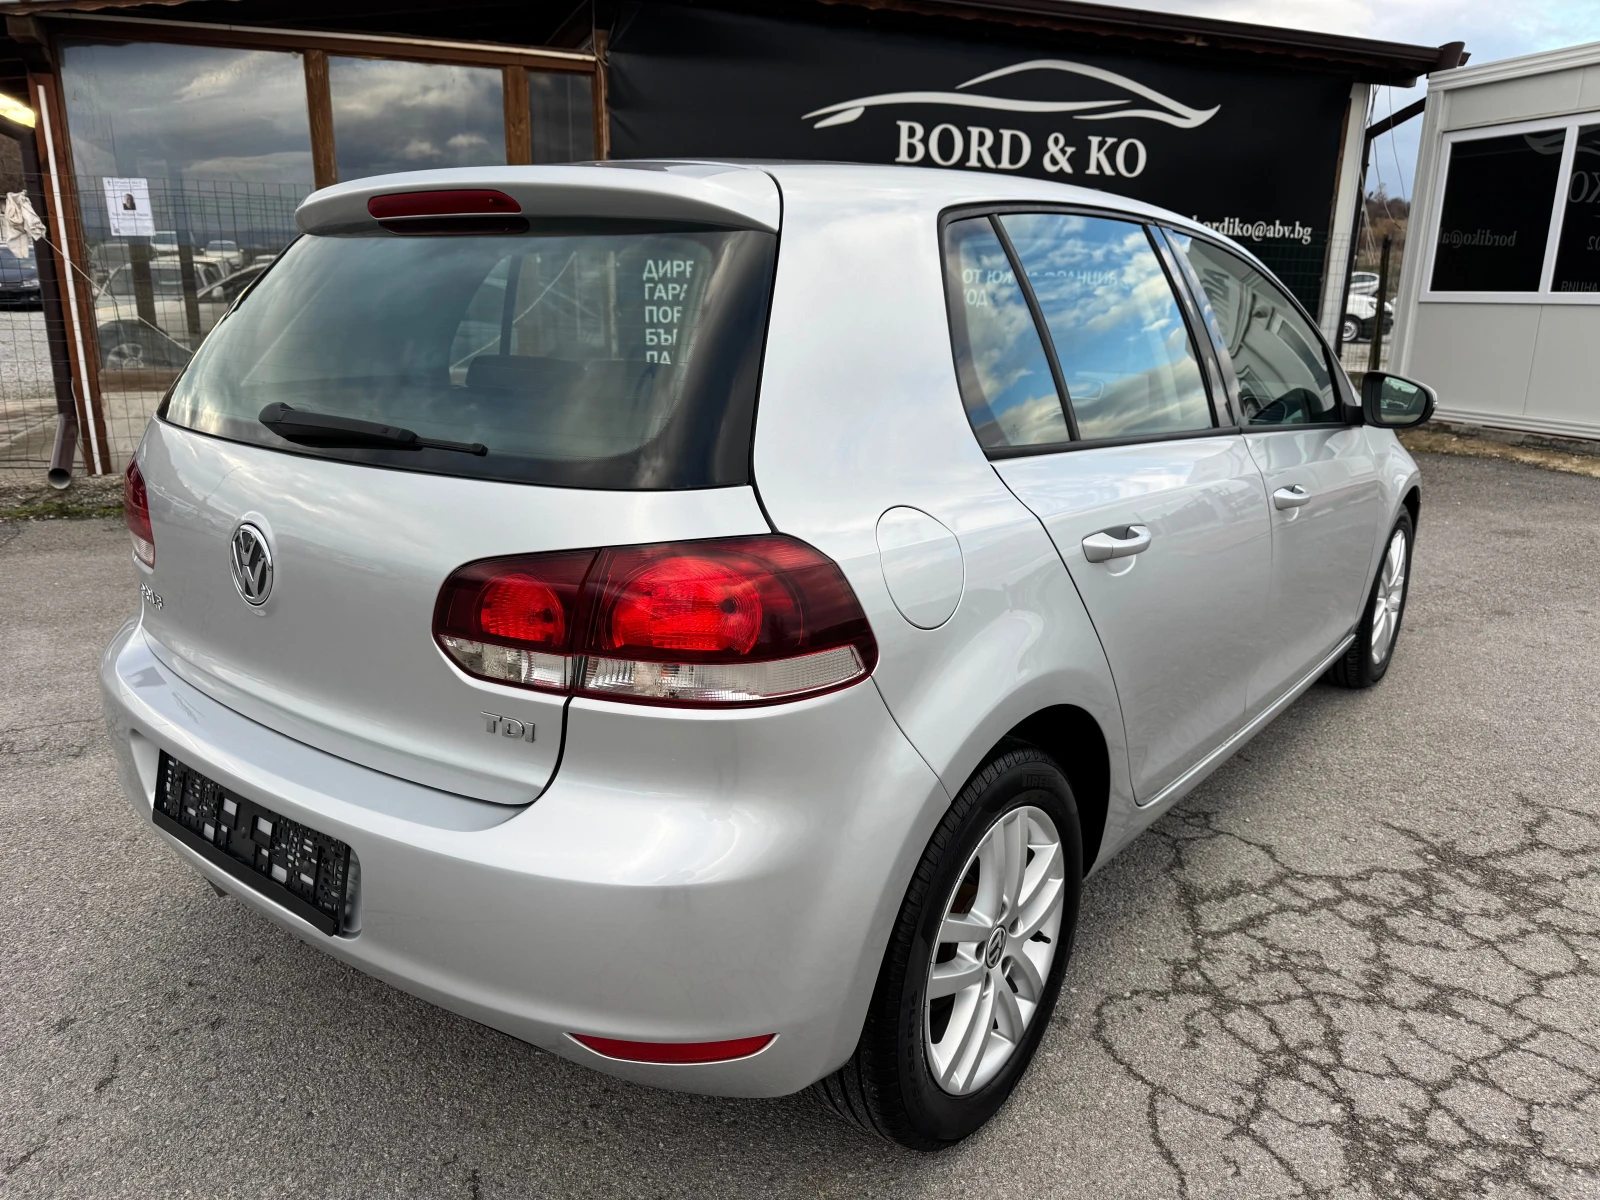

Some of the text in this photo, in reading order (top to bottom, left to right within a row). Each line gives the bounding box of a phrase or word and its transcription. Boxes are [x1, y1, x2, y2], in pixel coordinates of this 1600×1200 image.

[895, 120, 1147, 178] BORD & KO
[1192, 215, 1312, 245] rdiko@abv.bg
[962, 288, 988, 308] ОД
[480, 711, 536, 743] TDI
[1021, 767, 1058, 788] PIREL
